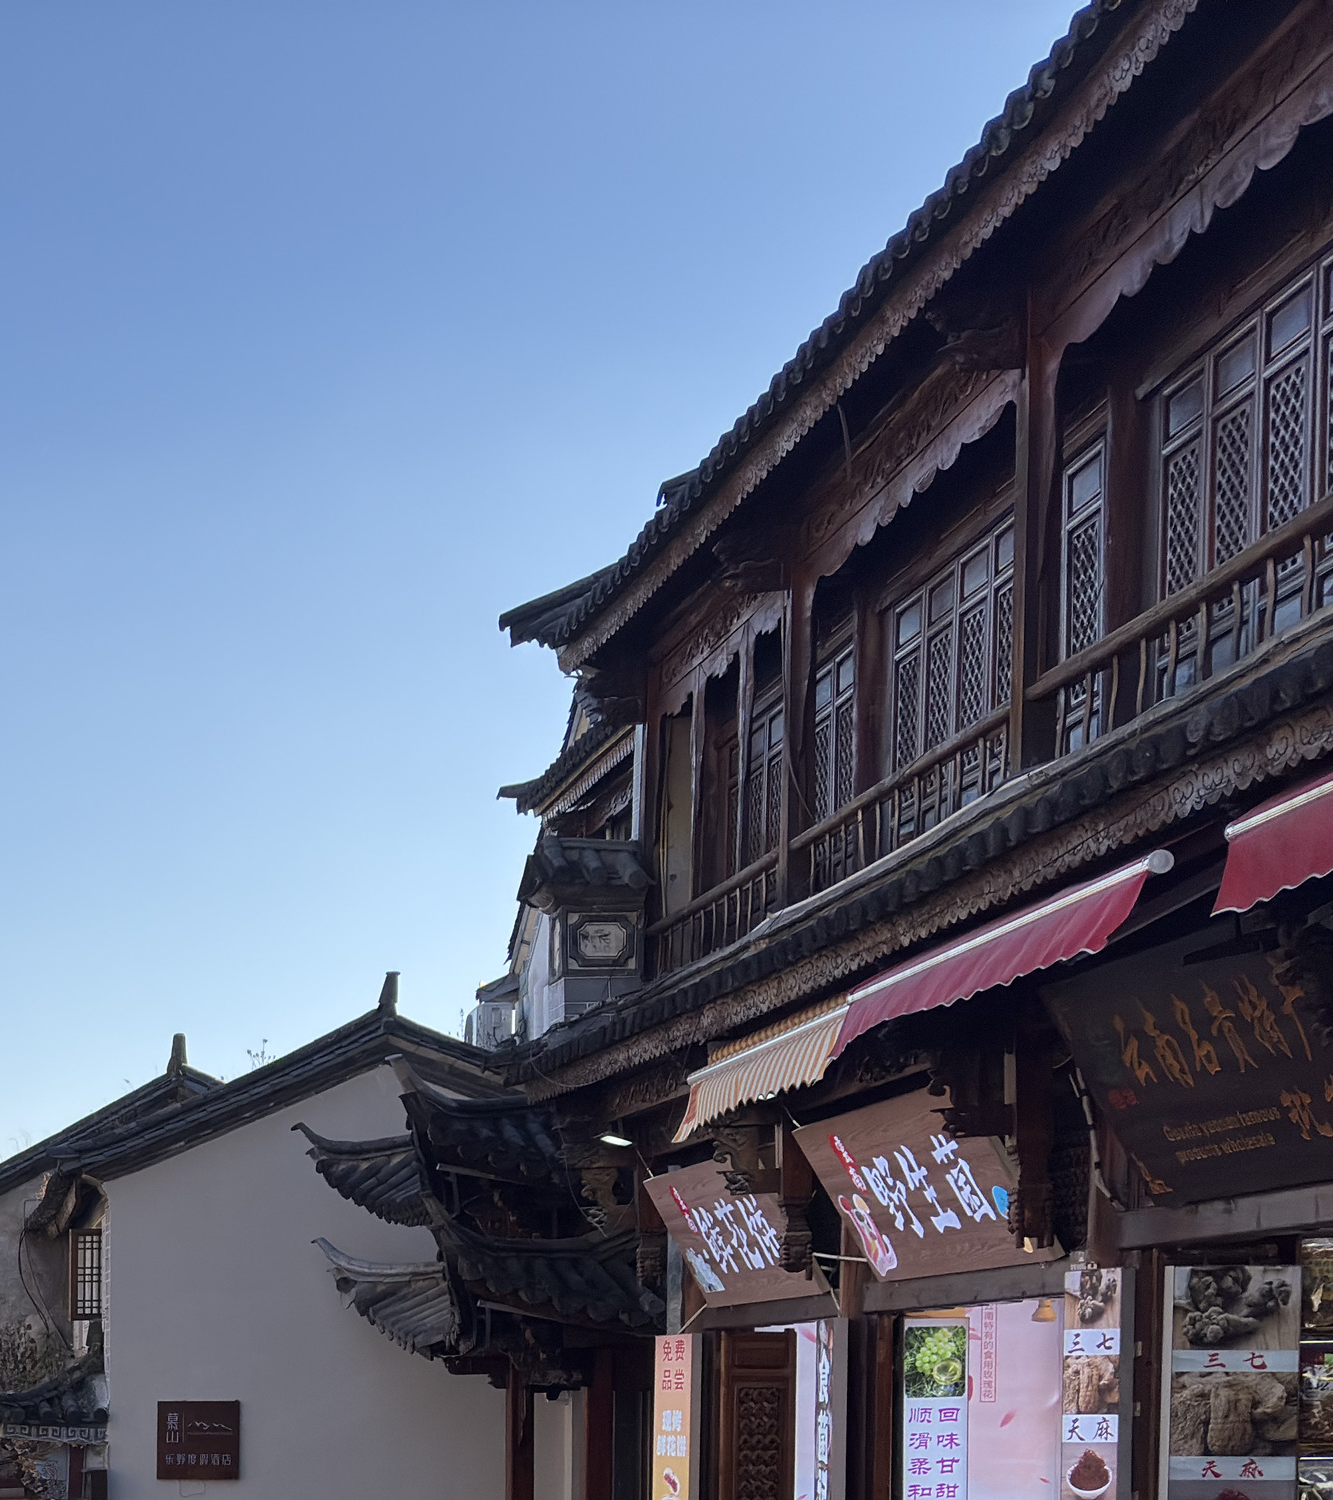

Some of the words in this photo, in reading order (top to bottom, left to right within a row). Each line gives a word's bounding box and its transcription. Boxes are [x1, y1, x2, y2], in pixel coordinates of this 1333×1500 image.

[861, 1134, 997, 1238] 野生菌
[691, 1194, 781, 1273] 鲜花饼
[662, 1339, 685, 1362] 免费
[1067, 1333, 1115, 1353] 三七
[1203, 1352, 1268, 1370] 三七
[662, 1368, 685, 1391] 品尝
[1067, 1416, 1115, 1442] 天麻
[908, 1407, 933, 1500] 顺滑柔和
[936, 1407, 961, 1499] 回味甘甜
[1202, 1458, 1264, 1478] 天麻
